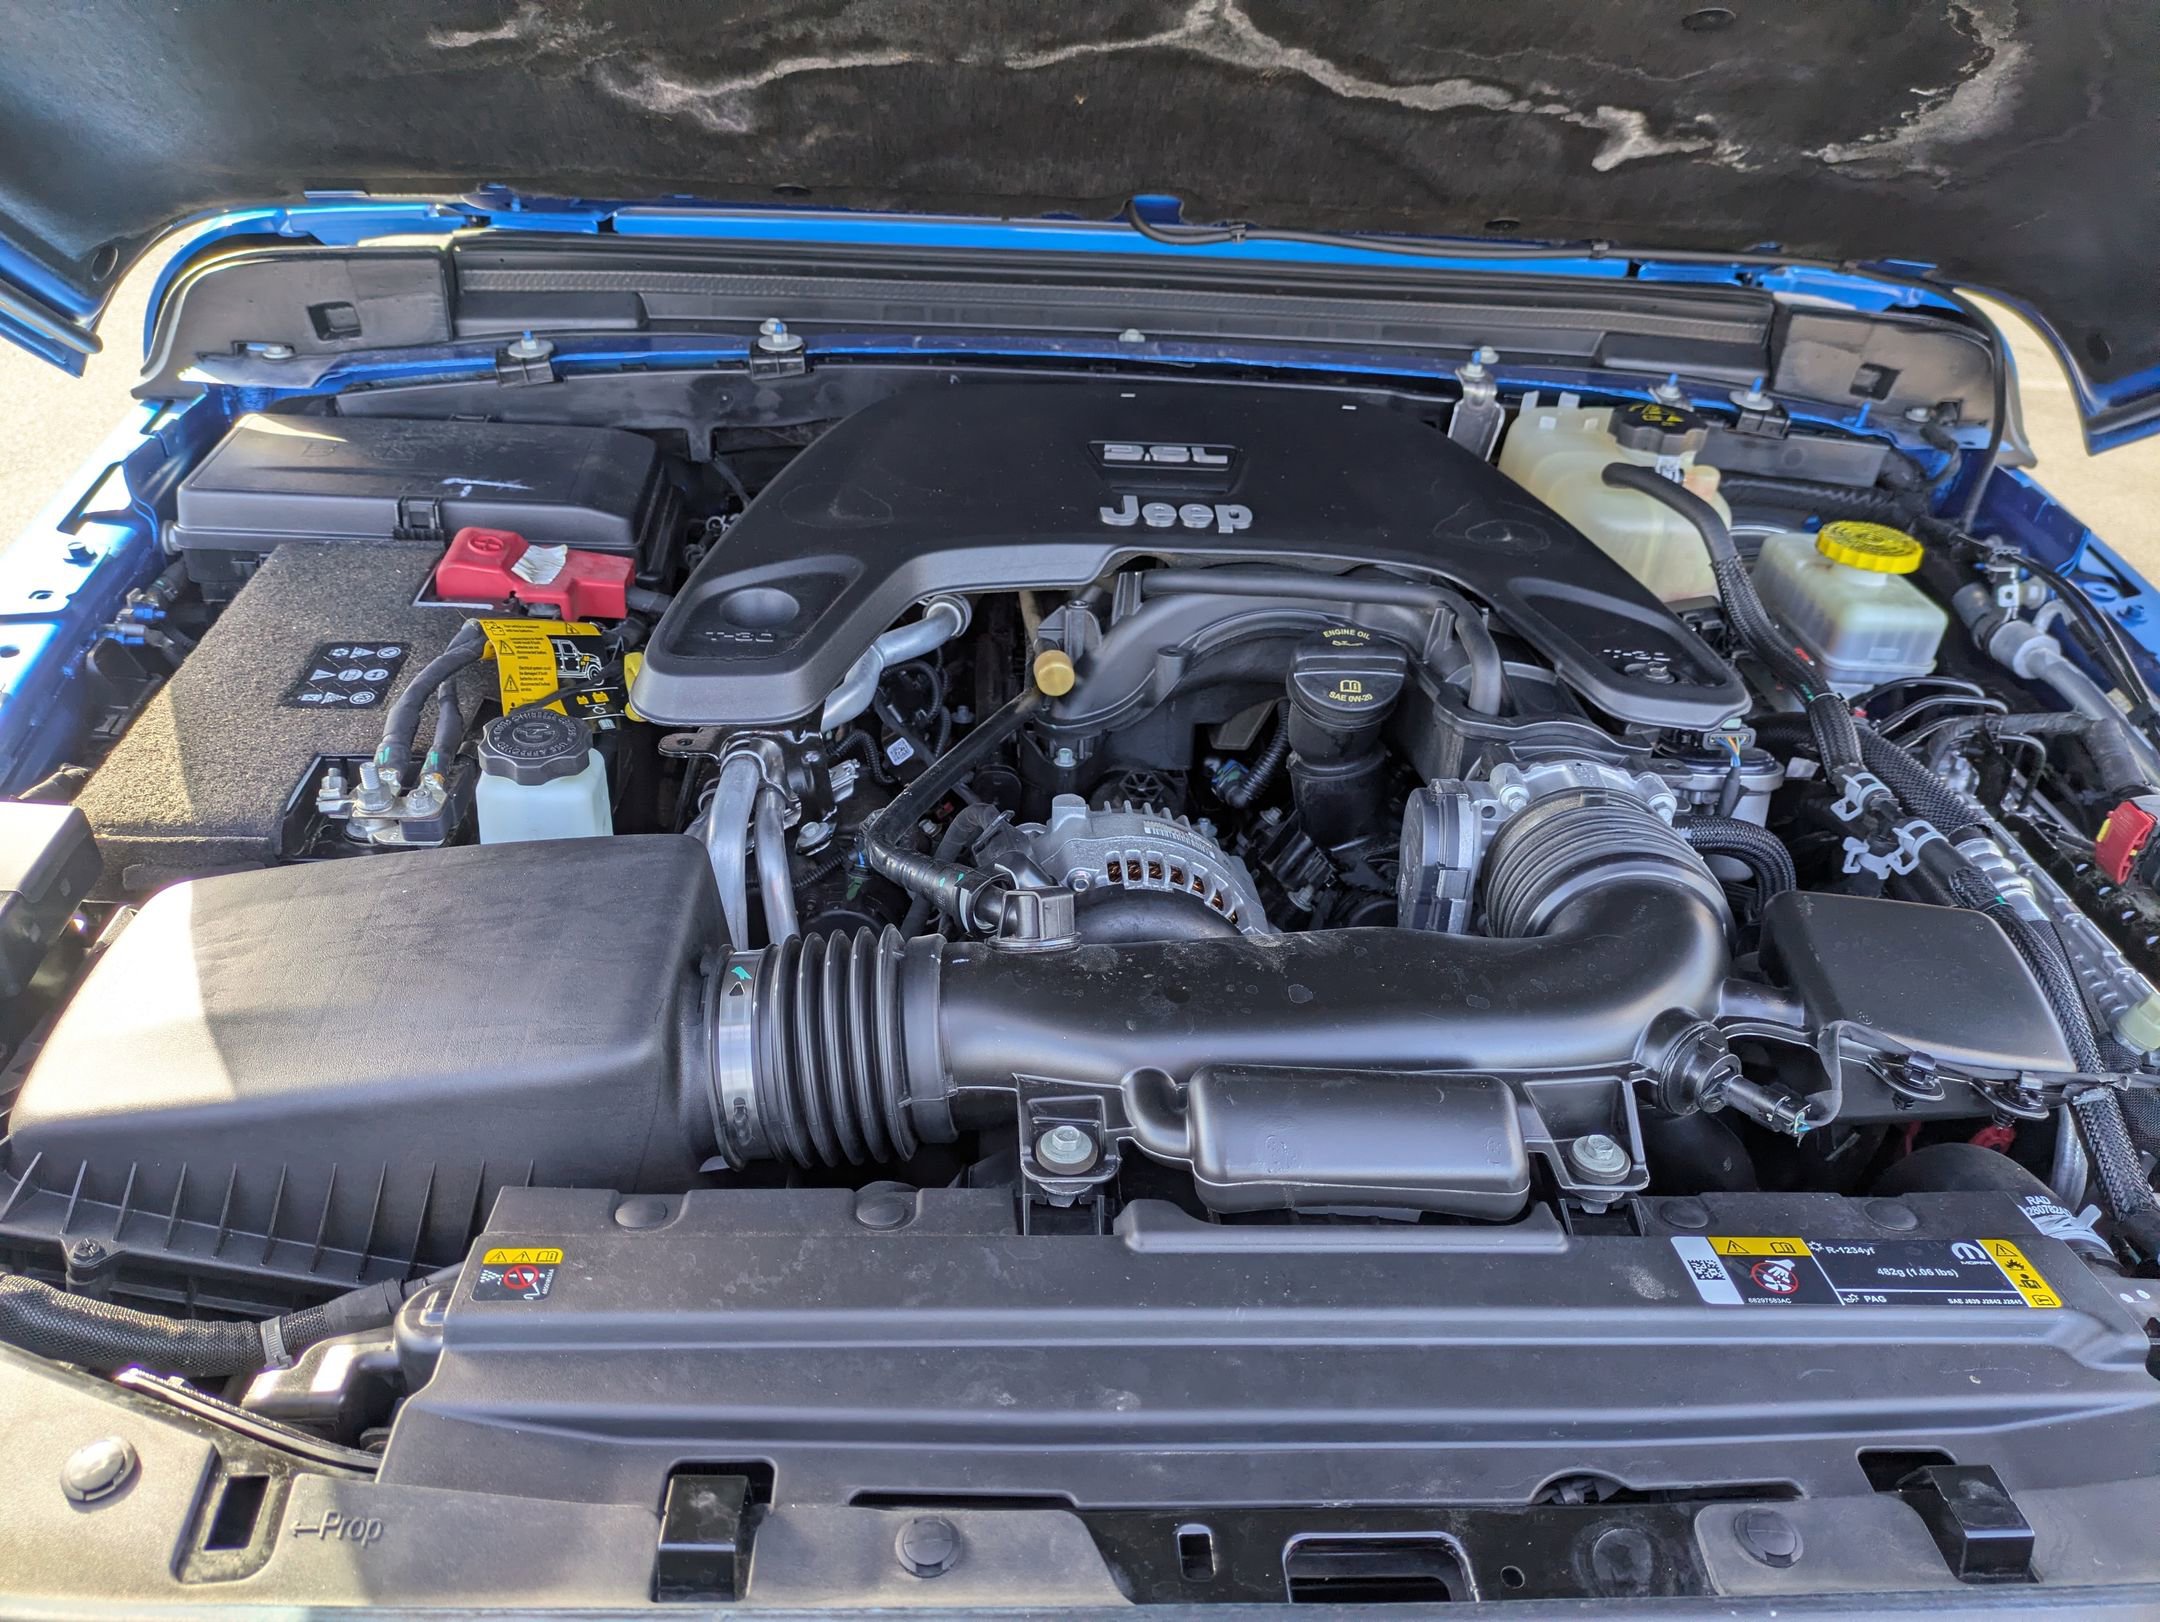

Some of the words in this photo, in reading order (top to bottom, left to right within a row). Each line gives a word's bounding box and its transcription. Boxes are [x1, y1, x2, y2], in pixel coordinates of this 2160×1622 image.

[1099, 495, 1253, 534] Jeep
[1323, 628, 1355, 638] ENGINE
[1357, 631, 1371, 641] OIL
[1328, 690, 1347, 702] SAE
[1348, 693, 1373, 703] 0W-20
[2025, 1195, 2051, 1205] RAD
[1825, 1246, 1876, 1256] R-1234yf
[1876, 1268, 1905, 1278] 482g
[1905, 1268, 1933, 1278] (1.06
[1934, 1268, 1959, 1278] lbs)
[1863, 1295, 1888, 1303] PAG
[319, 1509, 384, 1549] Prop
